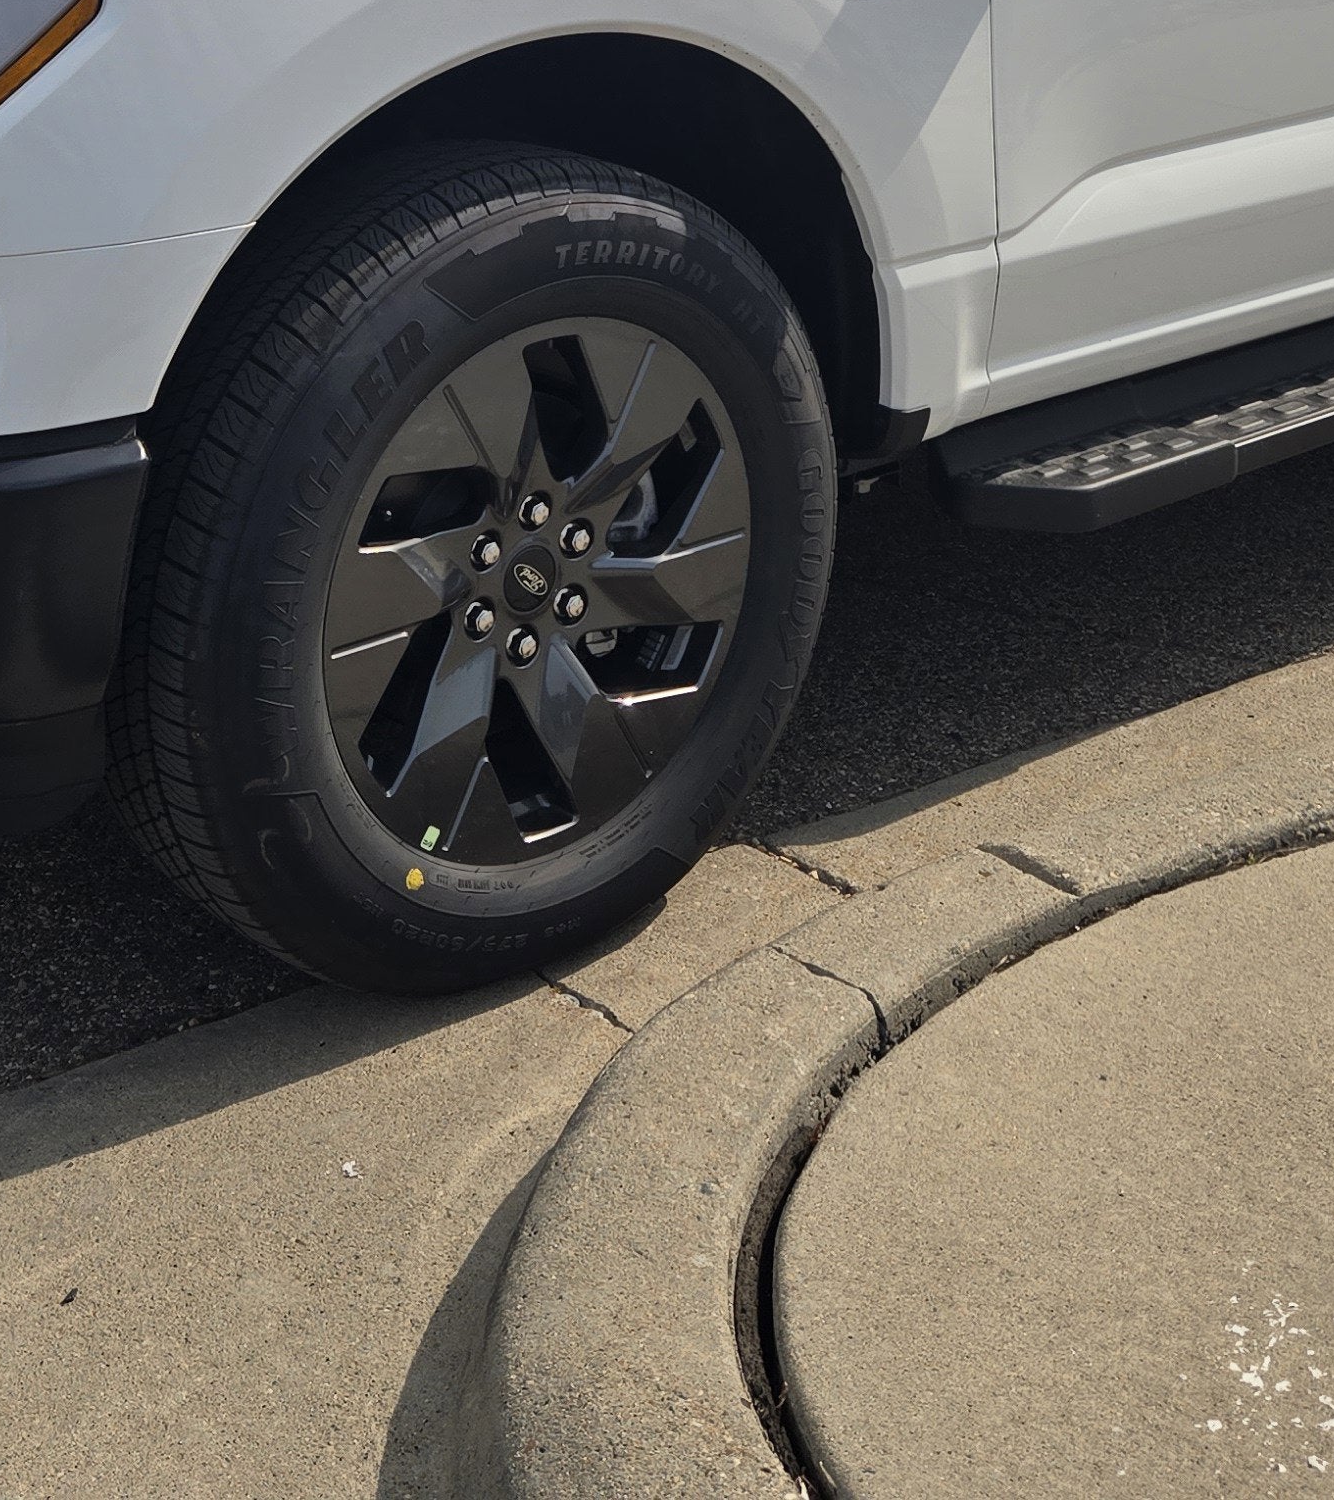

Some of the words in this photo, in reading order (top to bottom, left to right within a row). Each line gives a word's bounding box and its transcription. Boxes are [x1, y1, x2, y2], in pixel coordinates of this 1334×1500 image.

[554, 239, 724, 295] TERRITORY
[253, 318, 433, 758] WRANGLER
[519, 567, 544, 592] Ford
